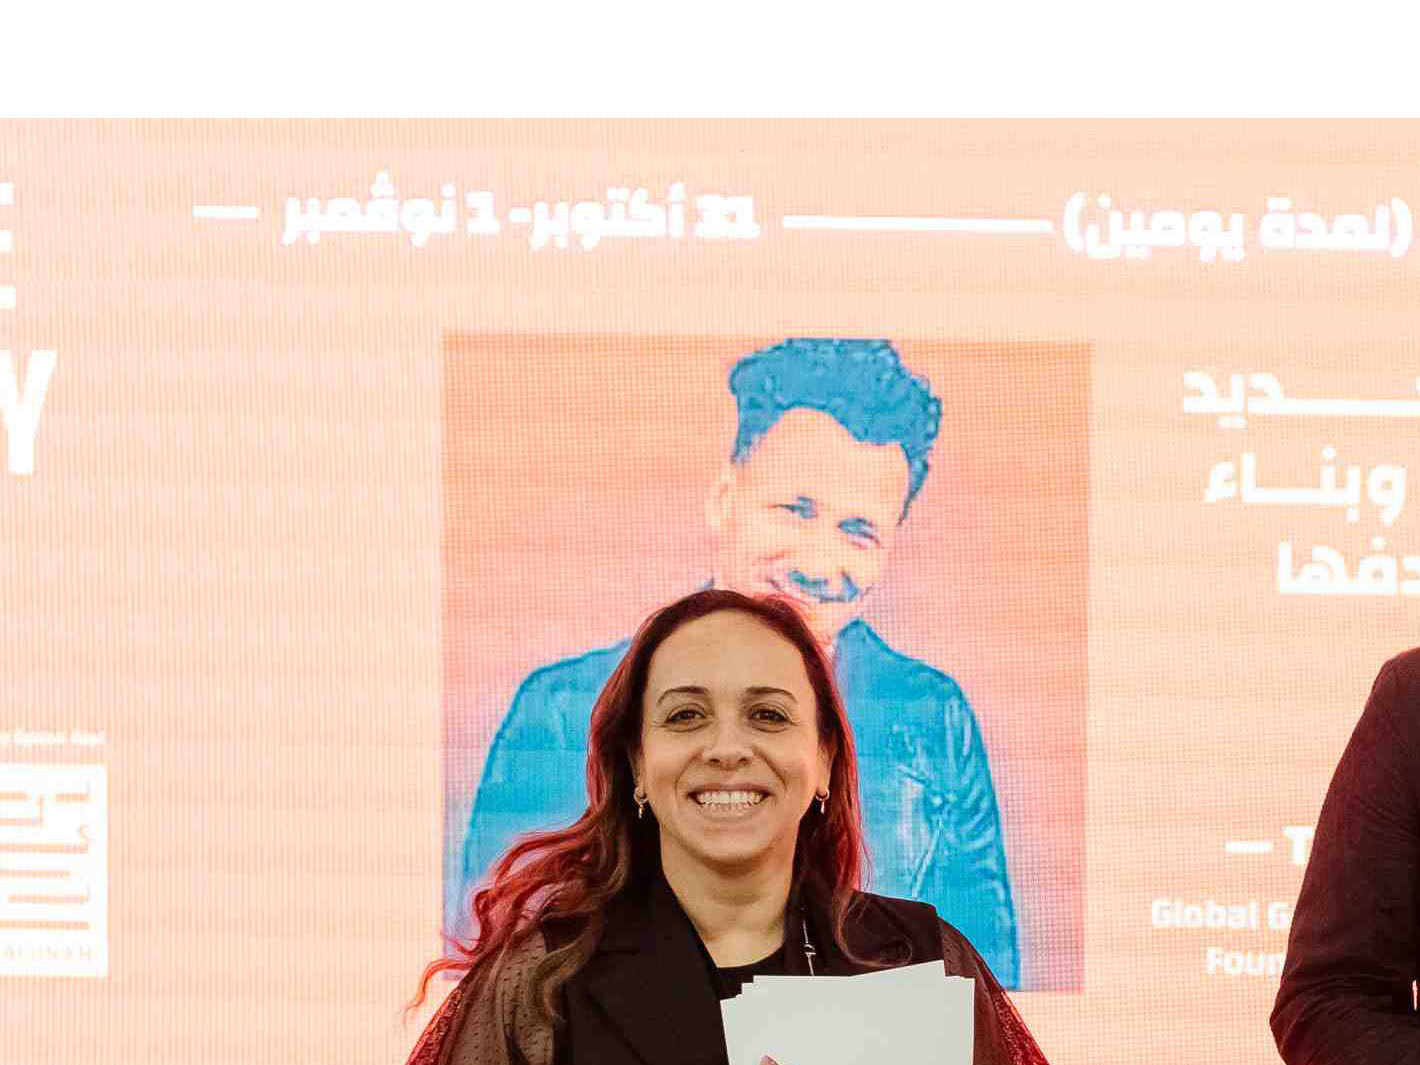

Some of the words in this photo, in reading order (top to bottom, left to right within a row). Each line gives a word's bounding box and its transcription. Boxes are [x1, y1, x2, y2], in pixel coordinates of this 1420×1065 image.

[1062, 191, 1246, 261] يومين)
[1259, 196, 1412, 258] (لمدة
[1151, 899, 1258, 929] Global
[1206, 947, 1286, 977] Foun
